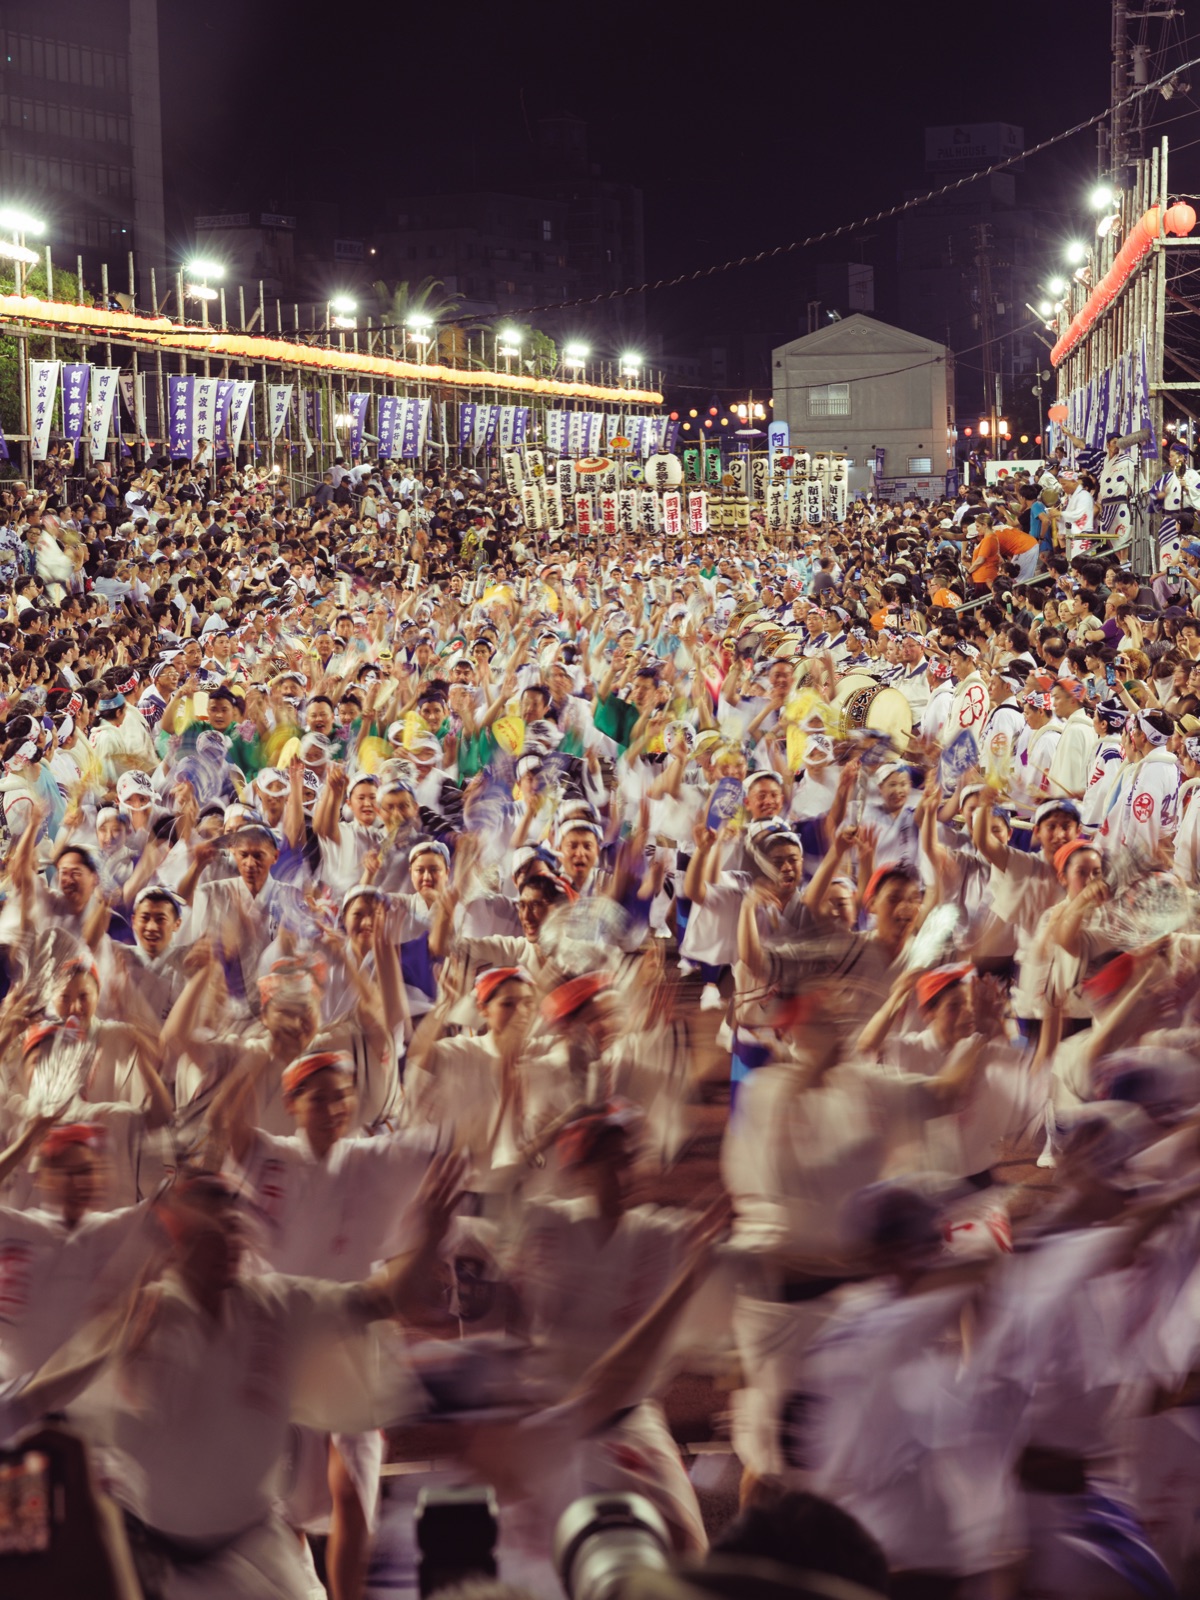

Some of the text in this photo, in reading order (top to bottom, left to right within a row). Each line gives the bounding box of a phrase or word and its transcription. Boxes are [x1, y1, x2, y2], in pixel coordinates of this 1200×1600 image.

[956, 145, 987, 156] HOUSE
[35, 369, 50, 431] 阿波銀行
[69, 370, 83, 432] 阿波銀行
[94, 375, 110, 432] 阿波銀行
[175, 381, 188, 435] 阿波銀行
[198, 384, 211, 435] 阿波銀行
[215, 386, 229, 436] 阿波銀行
[232, 387, 247, 434] 阿波銀行
[381, 400, 393, 440] 阿波銀行
[405, 403, 415, 441] 阿波銀行
[502, 410, 511, 442] 阿波銀行
[550, 413, 558, 444] 阿波銀行
[753, 461, 765, 500] のんき連
[577, 497, 590, 534] 水玉連
[603, 497, 616, 534] 水玉連
[620, 500, 633, 533] 天水連
[643, 502, 656, 534] 天水連
